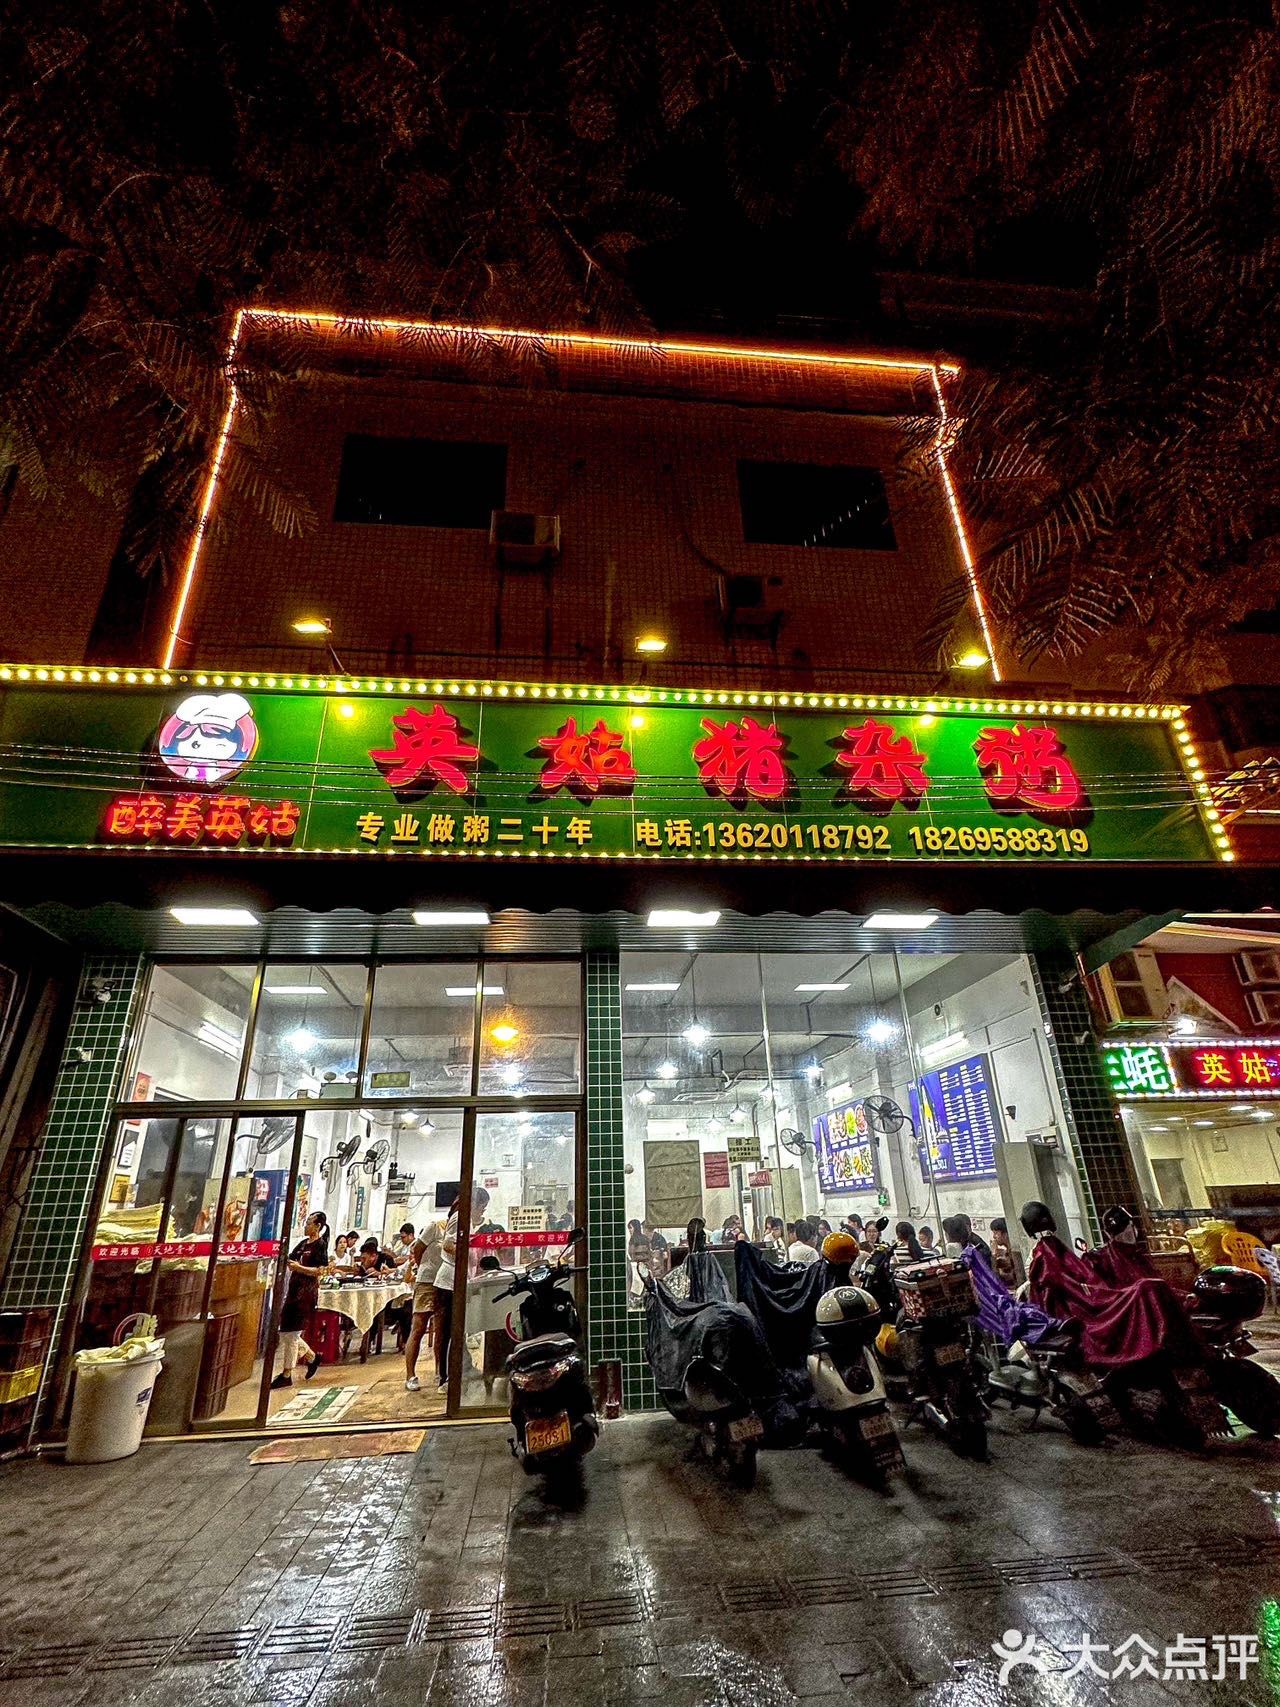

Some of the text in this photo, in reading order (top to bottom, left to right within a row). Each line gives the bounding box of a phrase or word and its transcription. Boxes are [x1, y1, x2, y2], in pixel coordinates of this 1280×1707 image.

[368, 703, 1080, 808] 英姑猪杂粥
[110, 796, 300, 839] 醉美英姑
[356, 811, 593, 845] 专业做粥二十年
[636, 818, 1089, 852] 电话:13620118792 18269588319
[1195, 1052, 1271, 1084] 英姑
